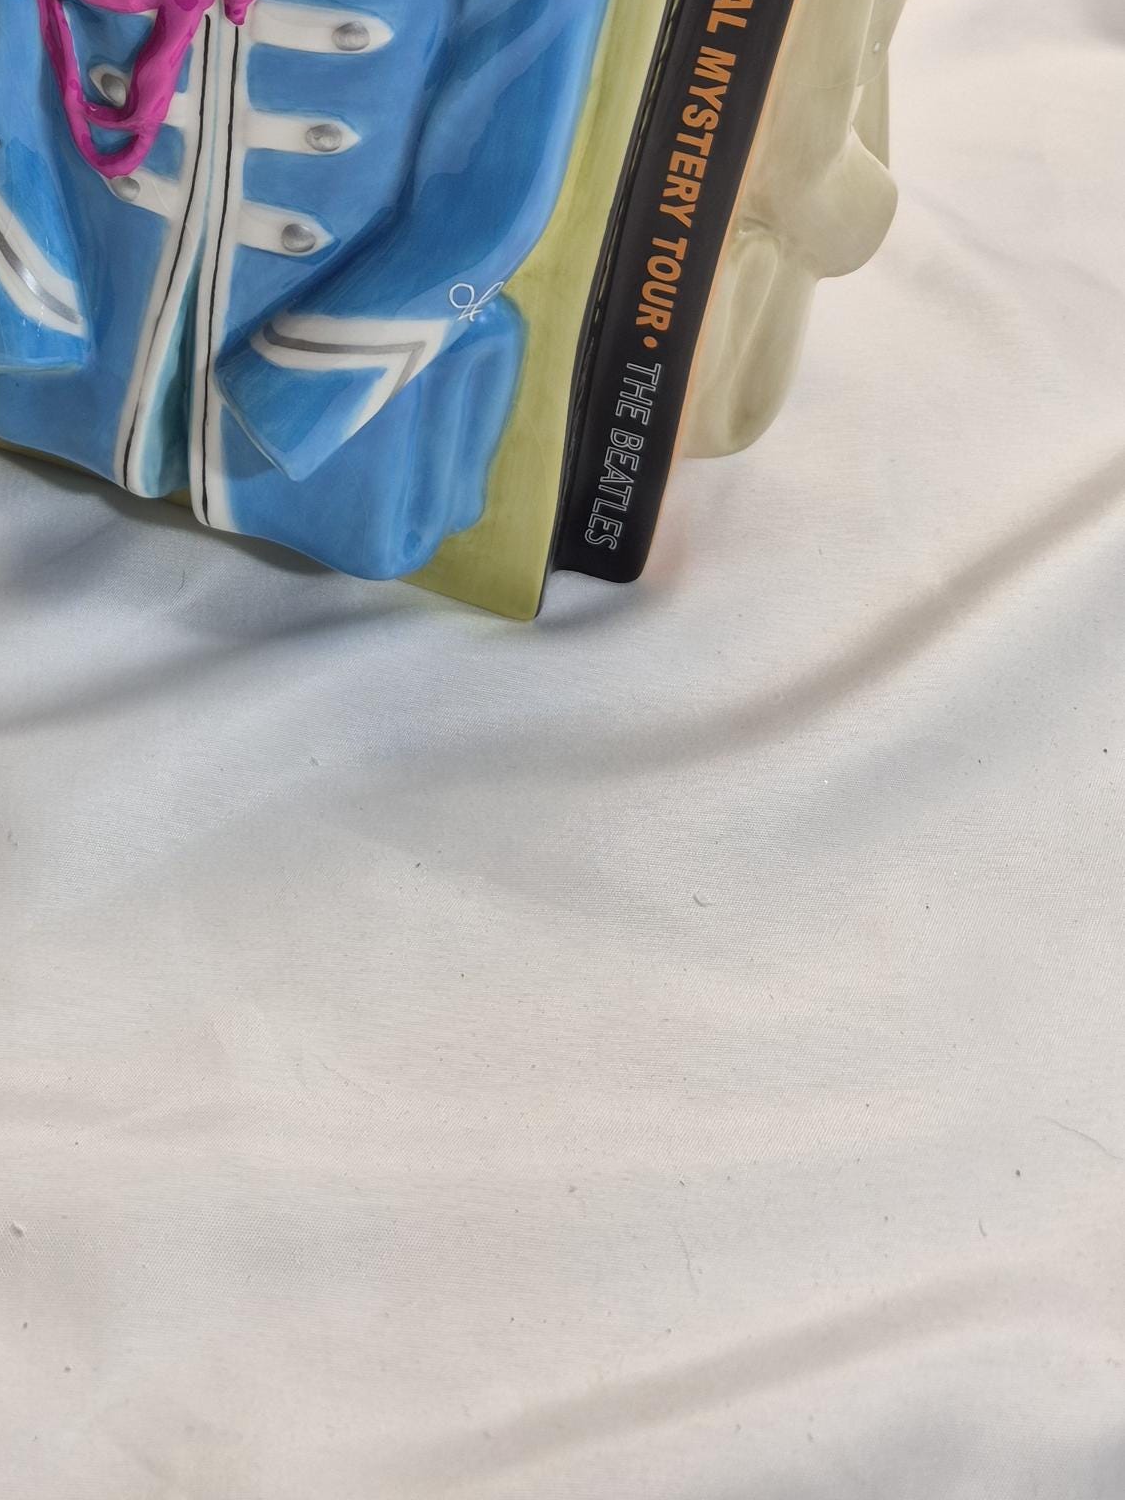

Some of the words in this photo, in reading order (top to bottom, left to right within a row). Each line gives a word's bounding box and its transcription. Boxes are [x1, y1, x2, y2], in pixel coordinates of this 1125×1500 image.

[659, 45, 737, 229] MYSTERY
[615, 362, 662, 425] THE
[584, 427, 645, 551] BEATLES
